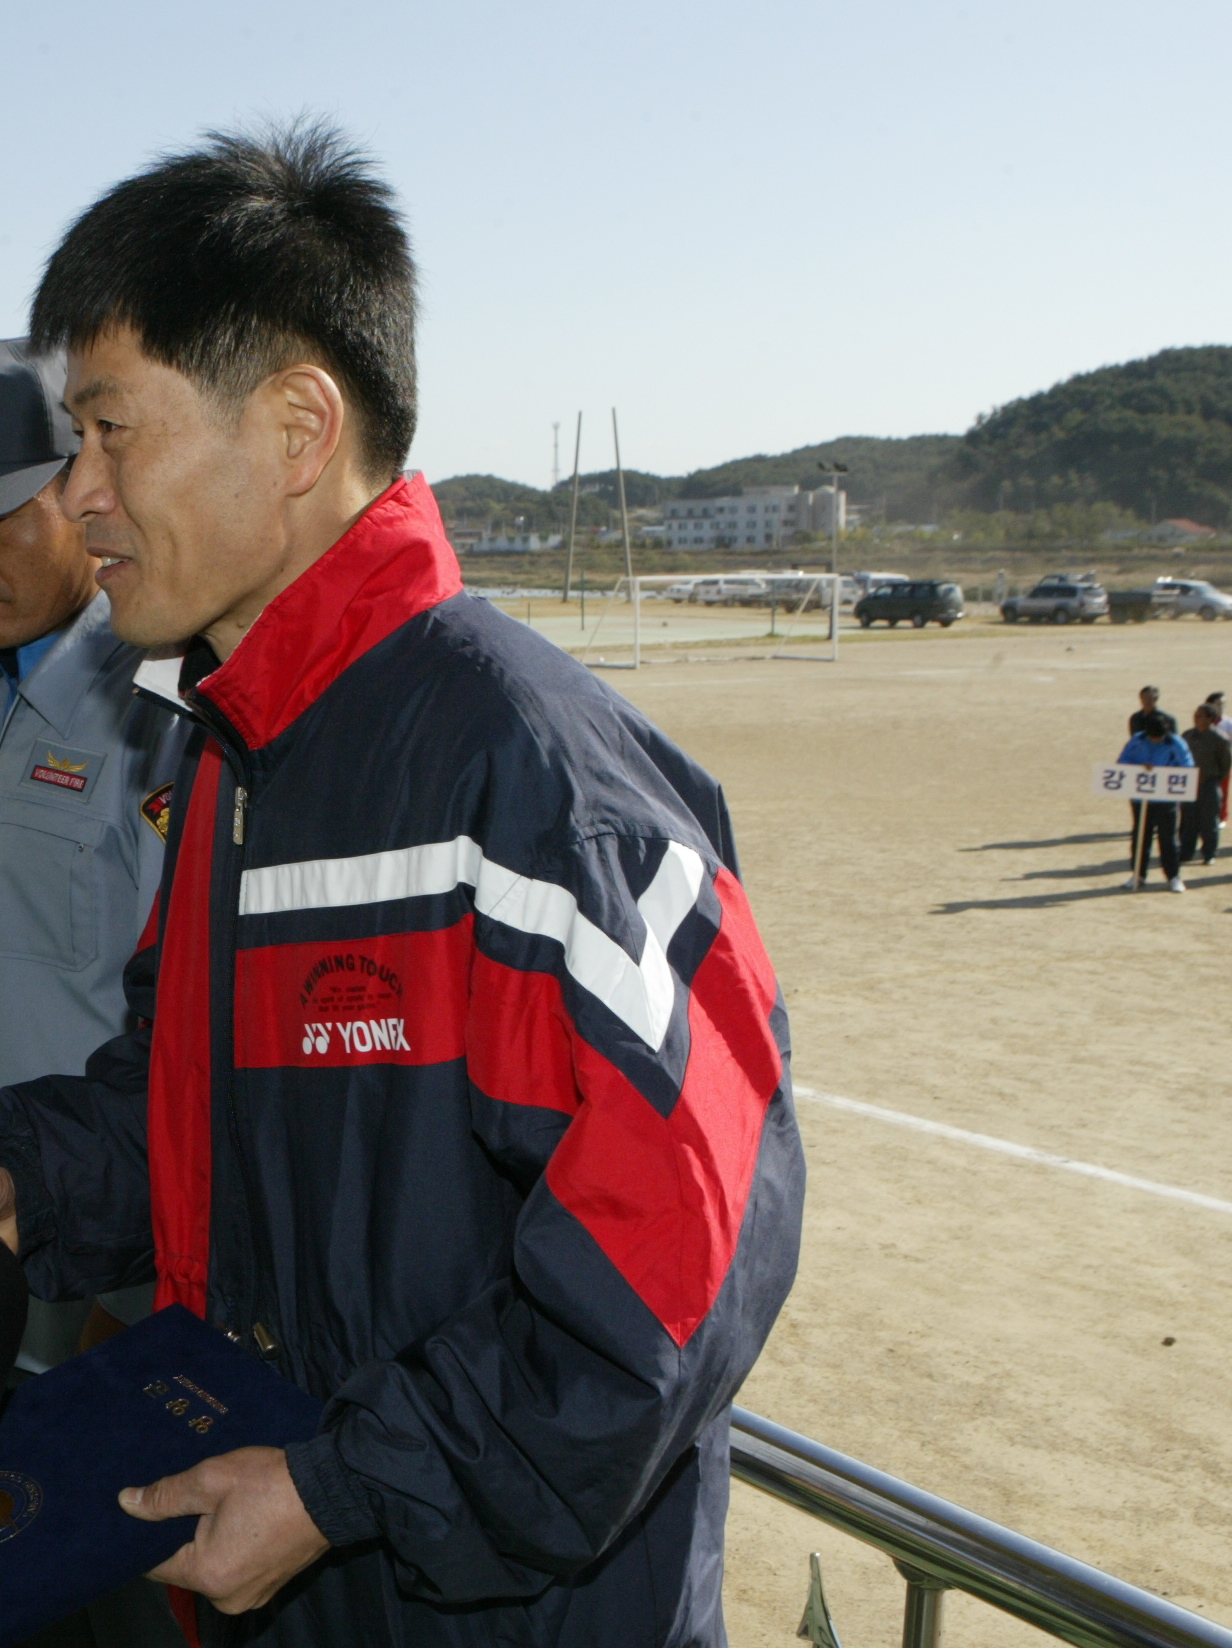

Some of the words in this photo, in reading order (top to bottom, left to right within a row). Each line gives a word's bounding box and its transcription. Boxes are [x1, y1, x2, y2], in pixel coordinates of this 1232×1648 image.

[35, 768, 70, 786] VOLUNTEER
[69, 777, 85, 789] FIRE
[304, 953, 356, 995] WINNING
